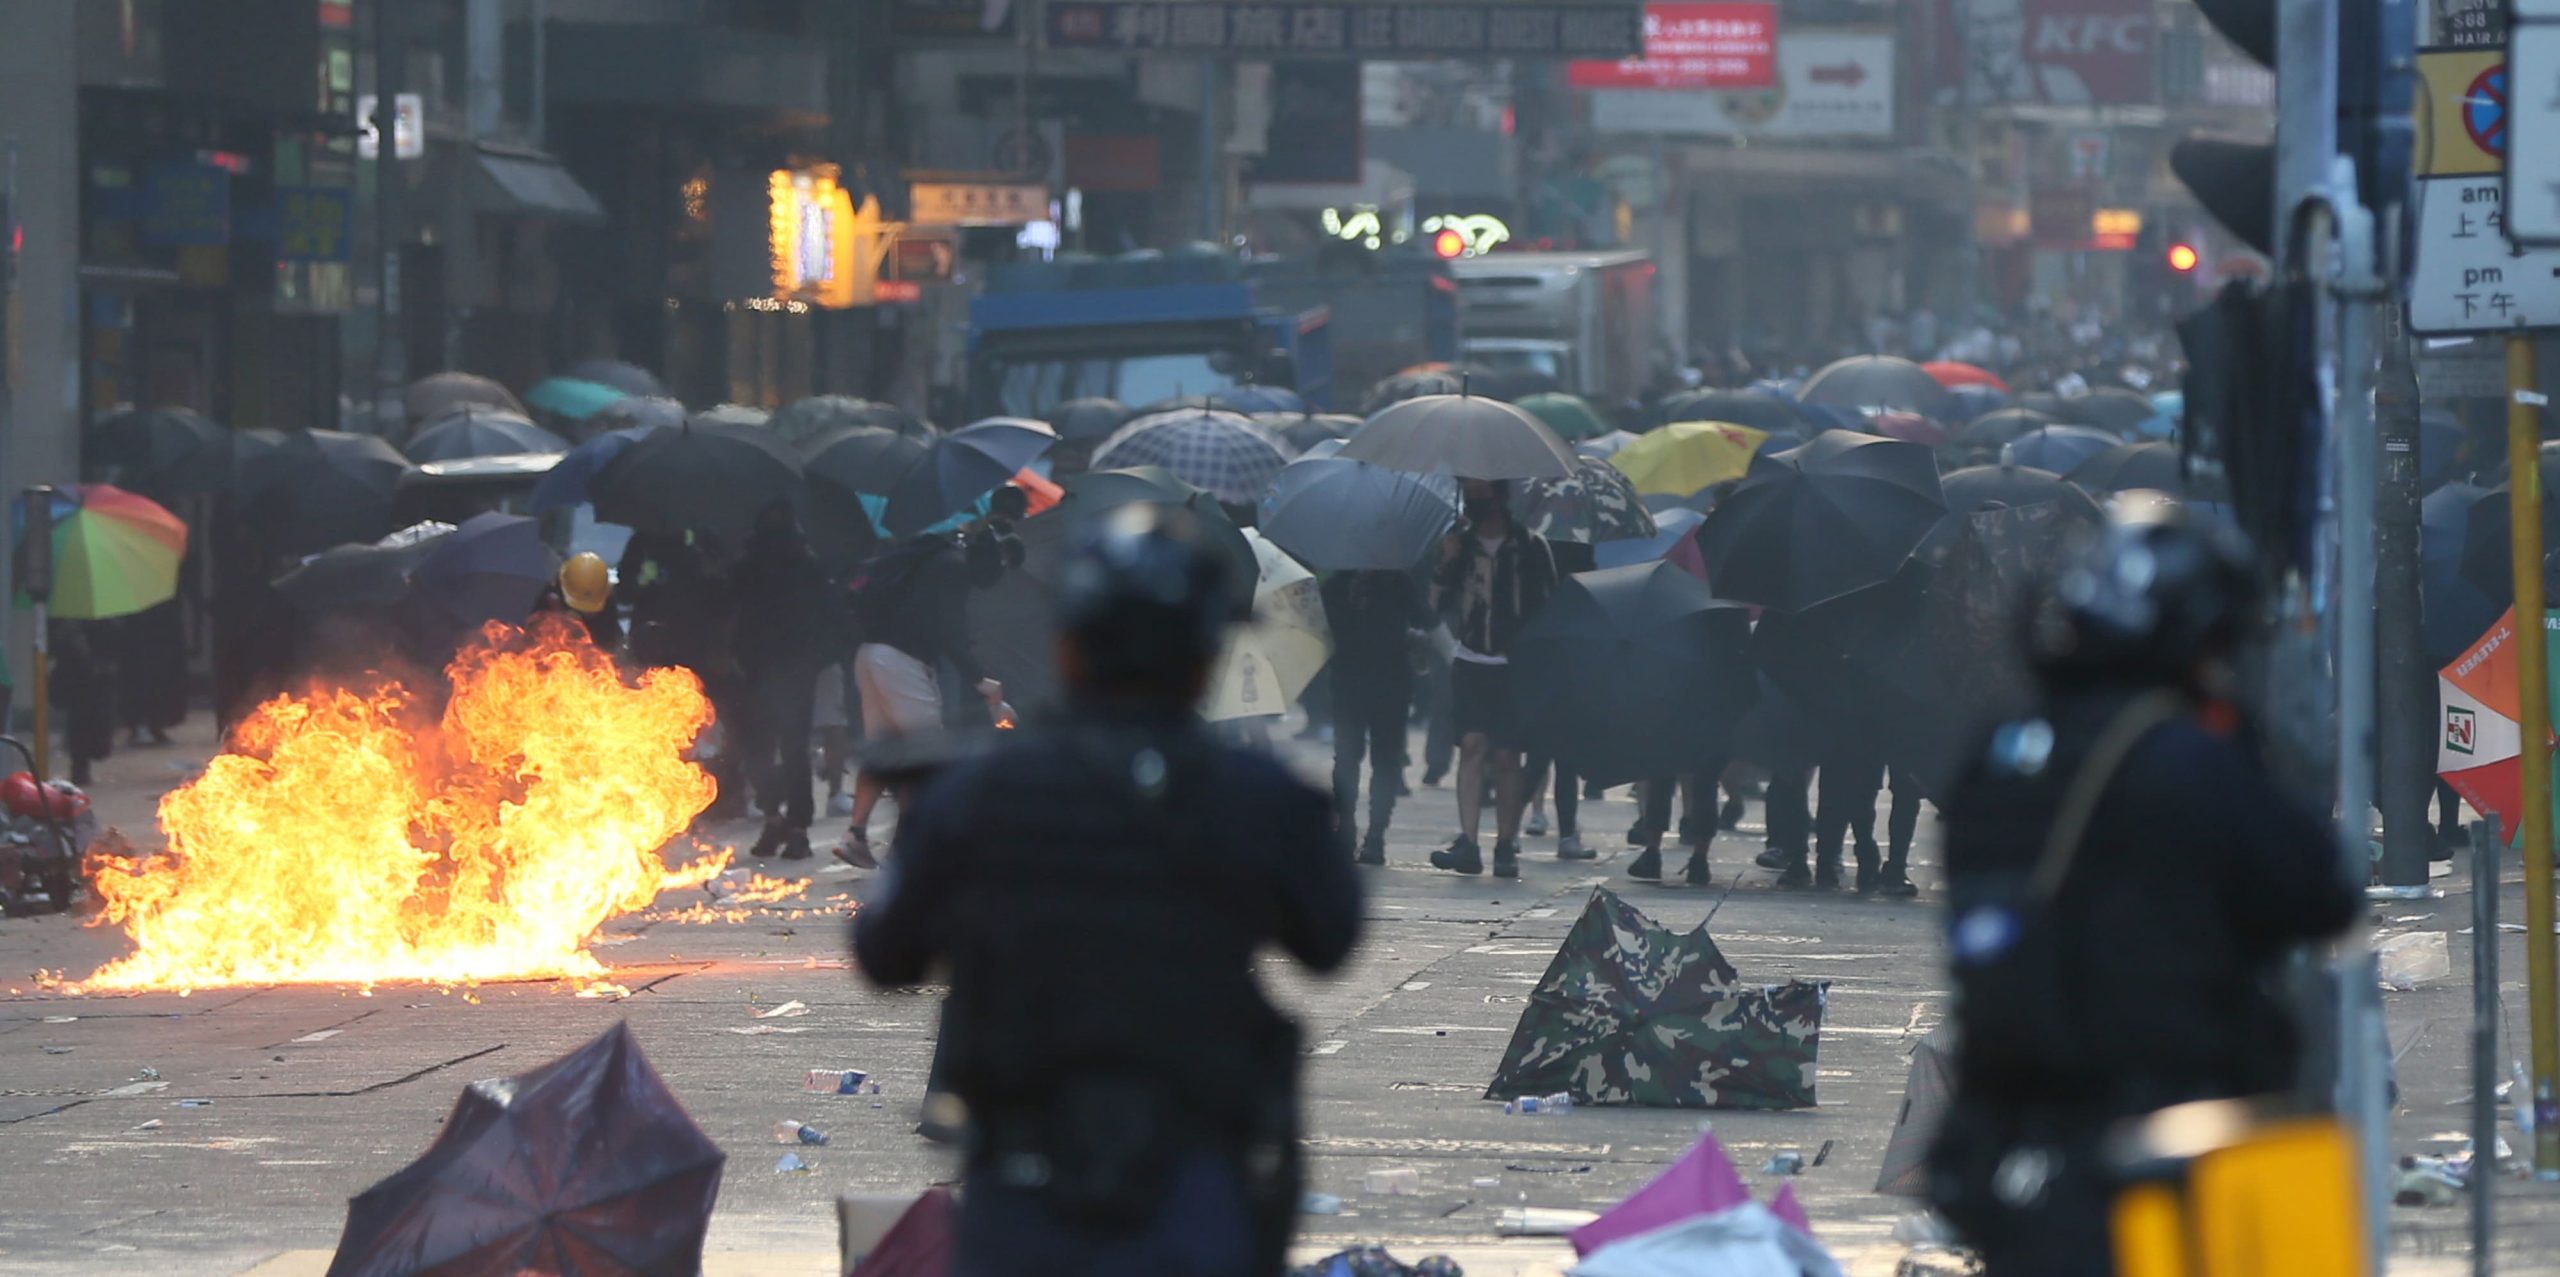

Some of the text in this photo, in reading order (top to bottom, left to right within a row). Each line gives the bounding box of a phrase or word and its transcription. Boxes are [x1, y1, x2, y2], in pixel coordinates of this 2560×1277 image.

[2034, 14, 2148, 54] KFC
[2461, 186, 2499, 203] am
[2464, 266, 2502, 288] pm
[2453, 292, 2516, 320] 下午
